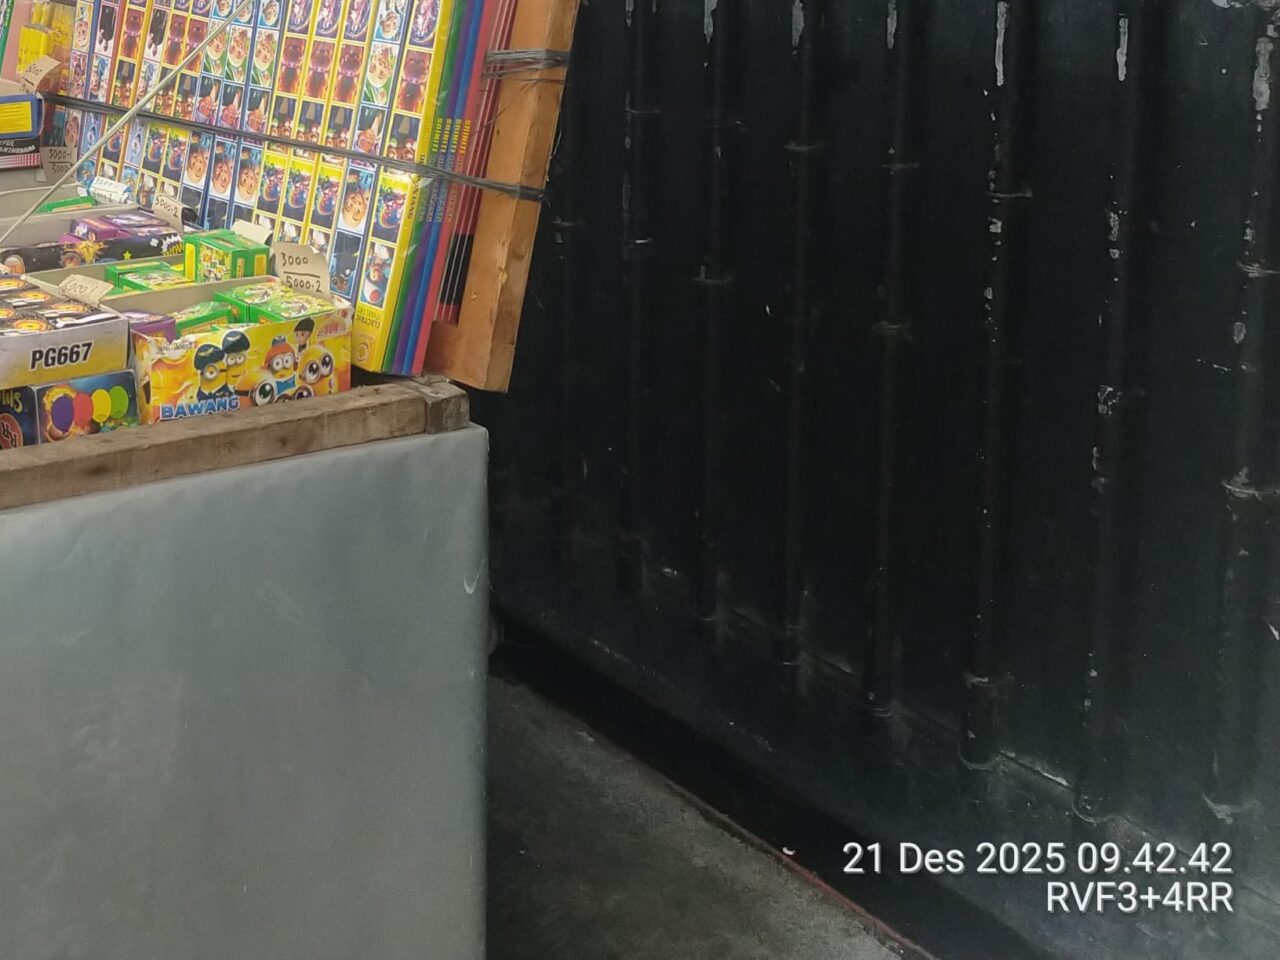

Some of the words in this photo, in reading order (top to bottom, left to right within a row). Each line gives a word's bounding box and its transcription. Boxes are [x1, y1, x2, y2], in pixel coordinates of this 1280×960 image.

[280, 251, 309, 268] 3000
[30, 341, 93, 371] PG667
[159, 396, 241, 420] BAWANG
